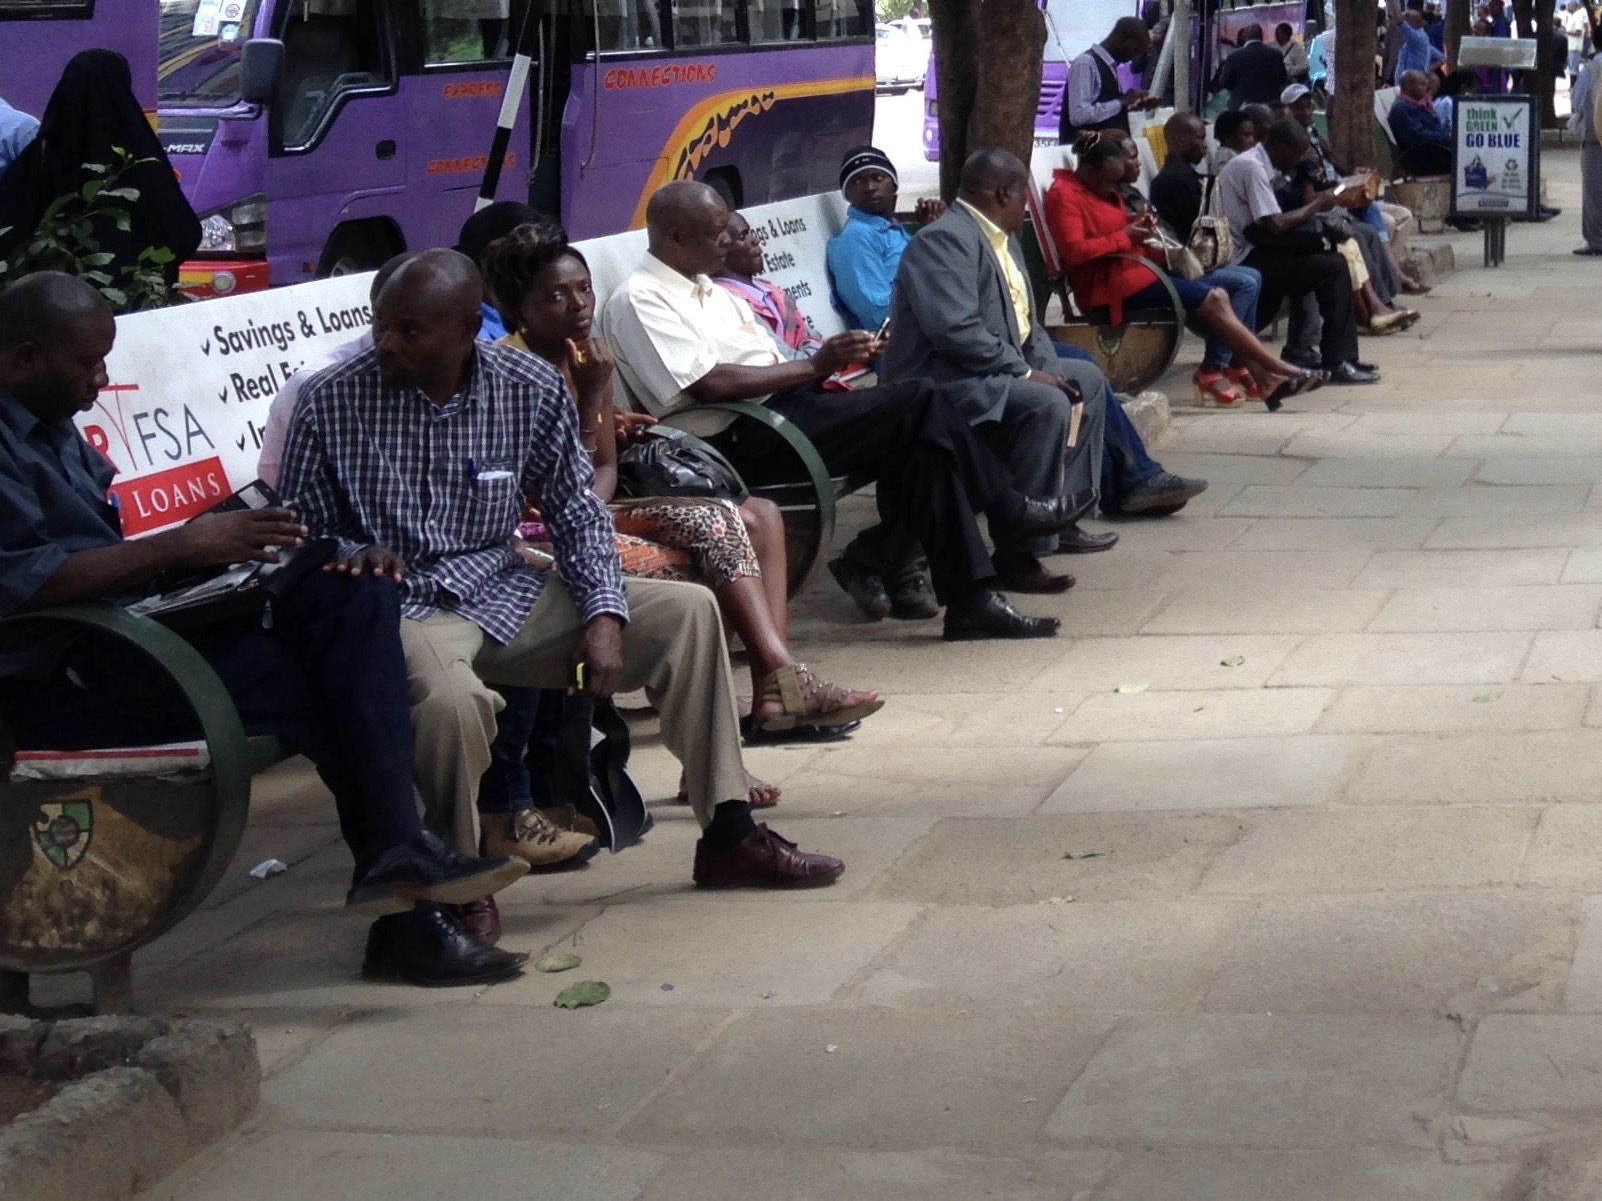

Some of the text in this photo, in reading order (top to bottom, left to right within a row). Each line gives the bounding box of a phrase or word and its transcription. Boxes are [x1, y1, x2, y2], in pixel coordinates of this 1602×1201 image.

[603, 62, 717, 91] CONNECTIONS
[1466, 108, 1498, 119] think
[1466, 120, 1498, 132] GREEN
[1466, 133, 1520, 148] GO BLUE
[767, 219, 779, 238] &
[776, 216, 807, 237] Loans
[763, 250, 796, 272] Estate
[213, 303, 373, 356] Savings & Loans
[229, 363, 279, 404] Real
[131, 403, 216, 466] FSA
[131, 472, 222, 519] LOANS
